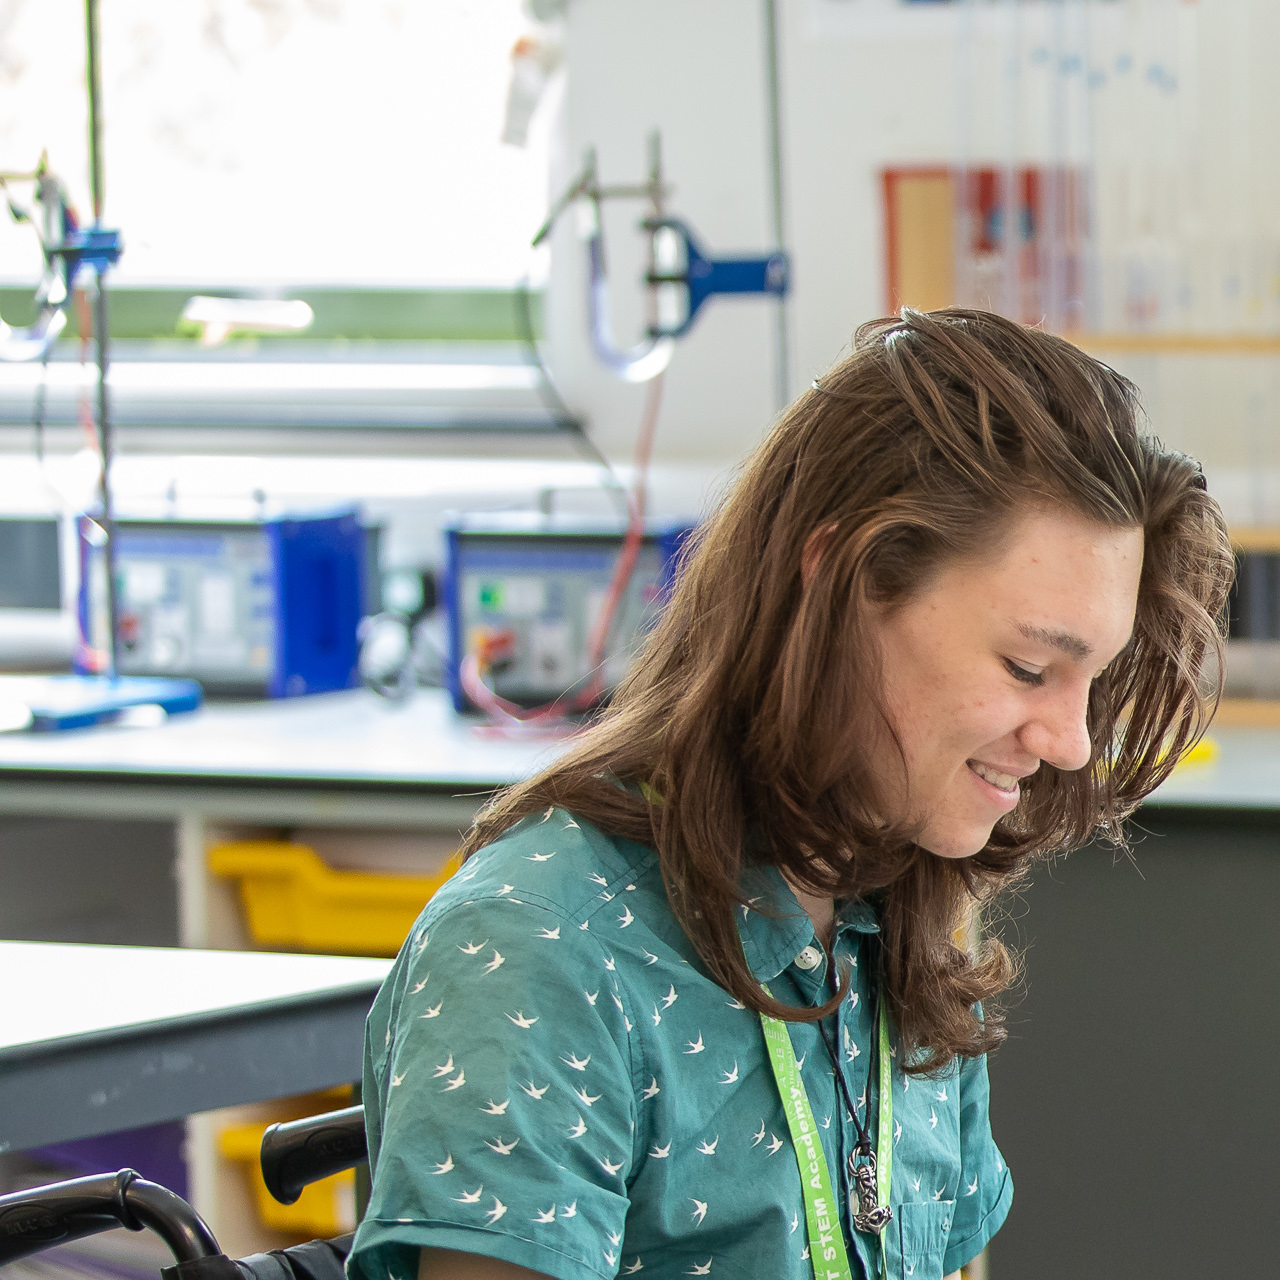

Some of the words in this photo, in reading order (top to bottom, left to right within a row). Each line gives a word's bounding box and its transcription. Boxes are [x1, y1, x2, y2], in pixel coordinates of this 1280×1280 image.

[790, 1086, 823, 1190] Academy
[879, 1120, 888, 1183] STEM
[813, 1197, 837, 1262] STEM
